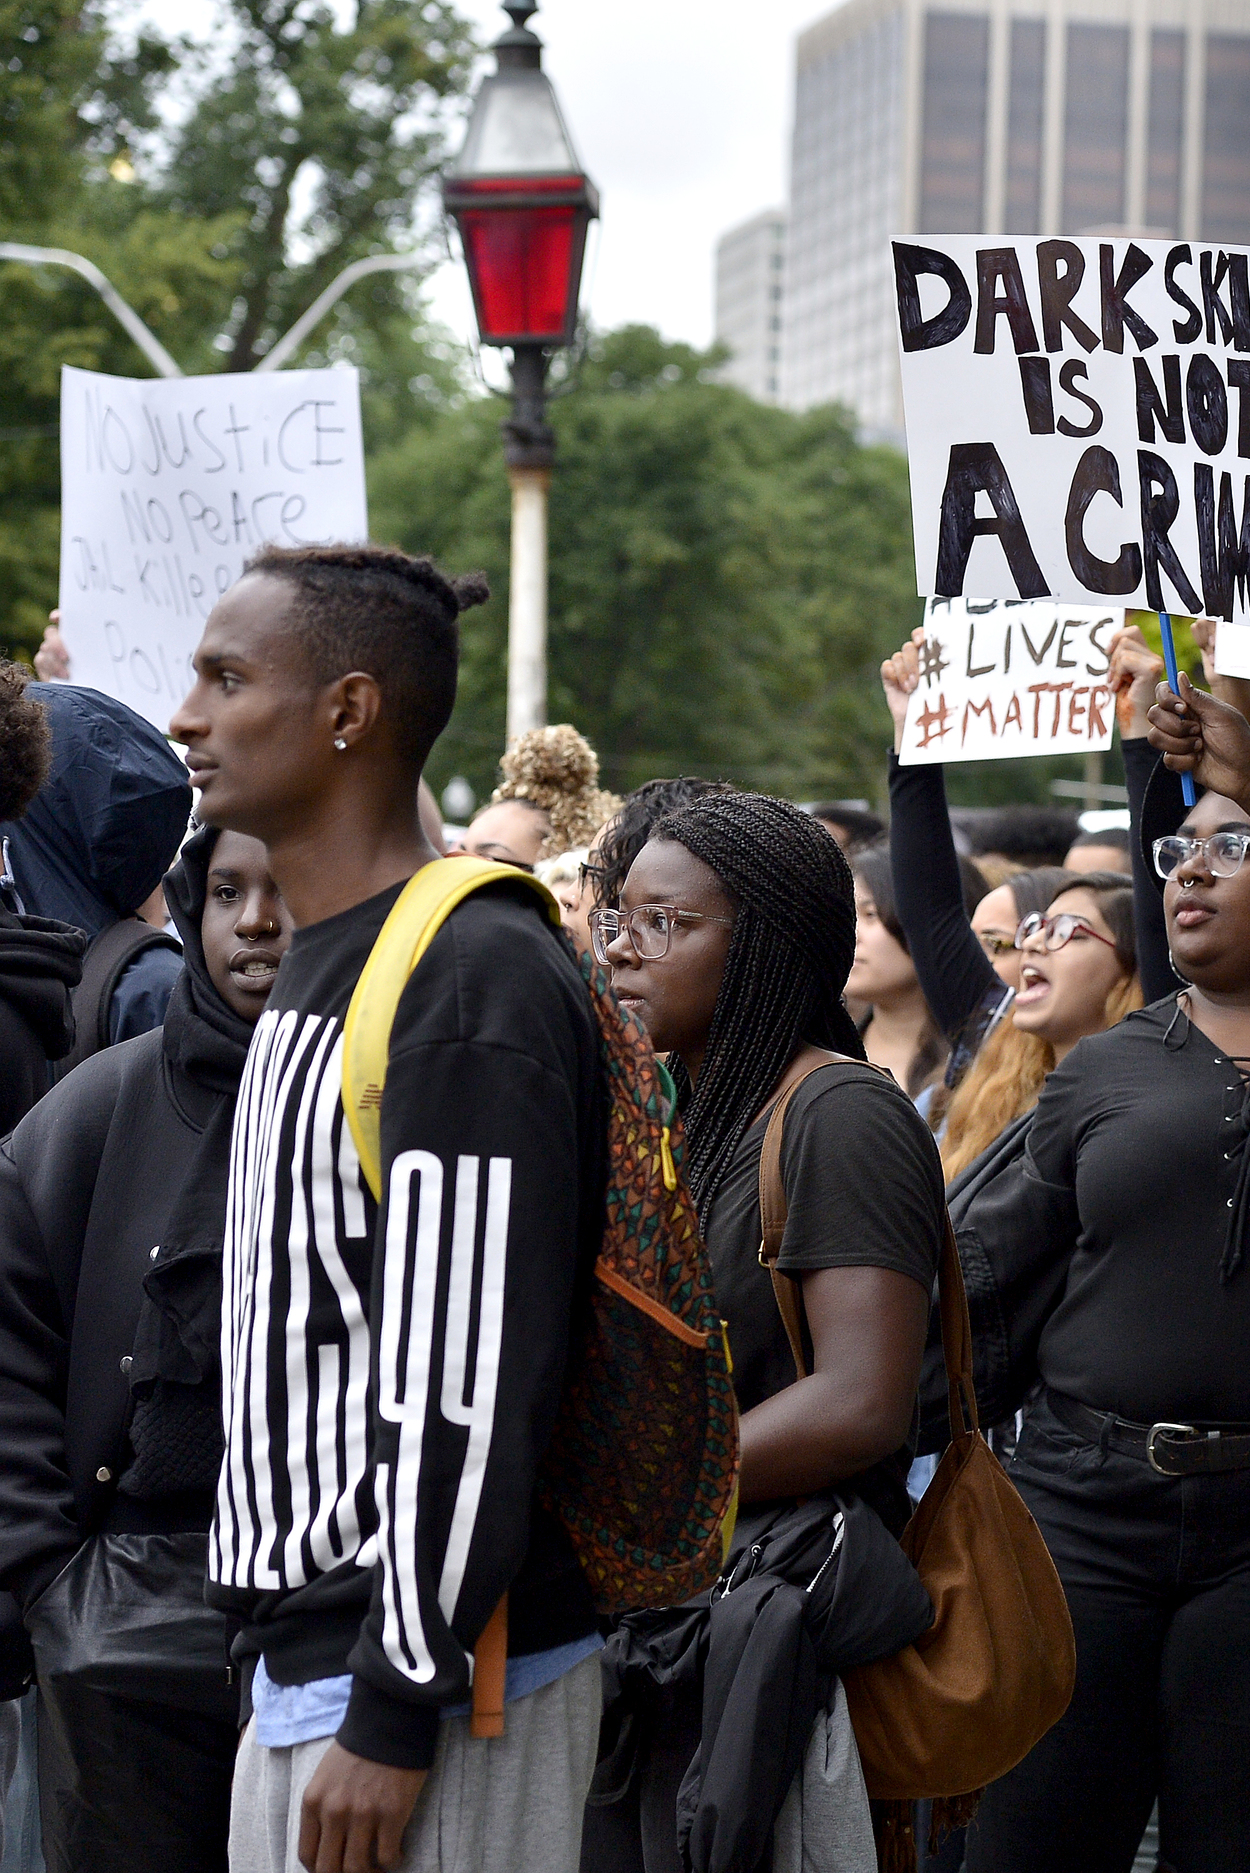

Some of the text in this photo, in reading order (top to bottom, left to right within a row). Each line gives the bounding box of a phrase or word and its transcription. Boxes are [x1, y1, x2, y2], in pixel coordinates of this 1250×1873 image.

[892, 240, 1159, 355] DARK
[1018, 356, 1103, 437] IS
[120, 488, 173, 545] NO
[935, 442, 1052, 600] A
